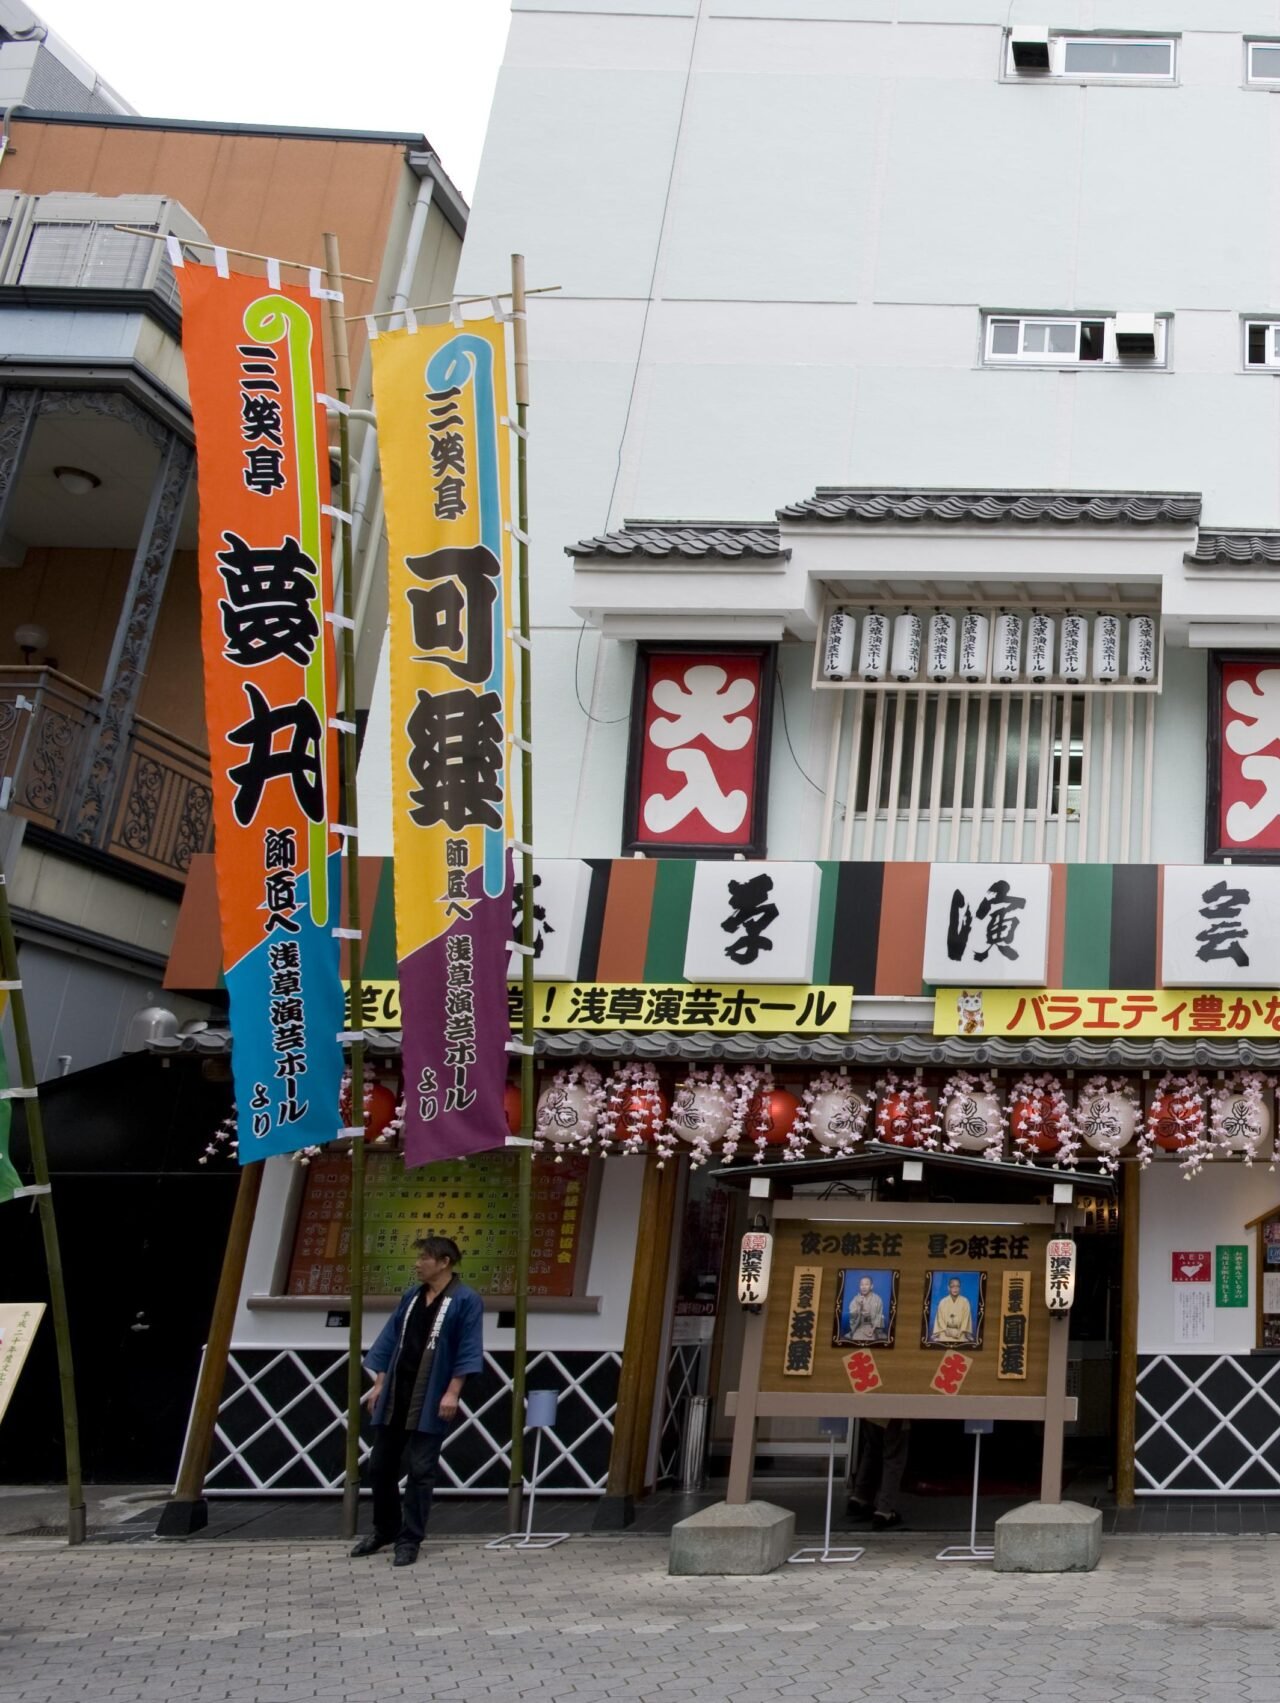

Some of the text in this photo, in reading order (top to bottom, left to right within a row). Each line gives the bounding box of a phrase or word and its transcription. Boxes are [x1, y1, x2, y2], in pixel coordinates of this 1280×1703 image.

[424, 386, 468, 522] 三笑亭
[236, 344, 286, 497] 三笑亭
[268, 940, 309, 1127] 浅草演芸ホール
[644, 664, 755, 834] 大入
[444, 934, 478, 1113] 浅草演芸ホール
[249, 1082, 271, 1140] より
[417, 1068, 440, 1123] より
[801, 1232, 903, 1256] 夜の部主任
[928, 1234, 1029, 1260] 昼の部主任
